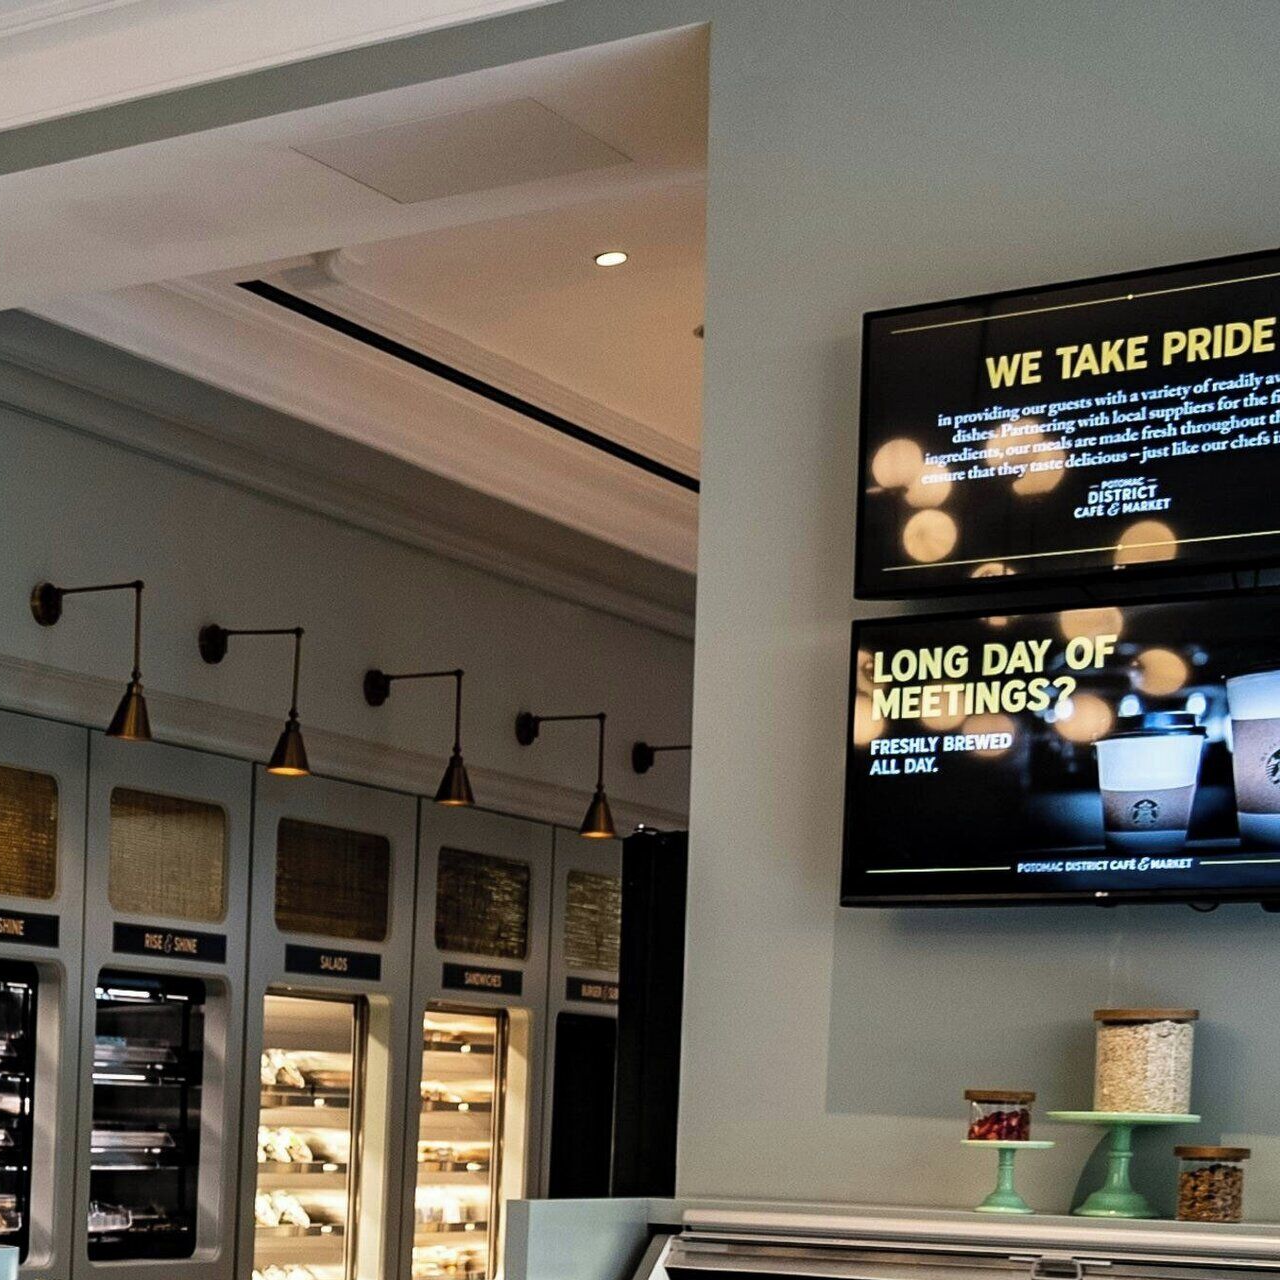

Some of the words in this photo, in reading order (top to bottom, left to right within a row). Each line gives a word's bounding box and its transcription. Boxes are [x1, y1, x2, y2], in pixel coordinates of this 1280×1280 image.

[986, 350, 1042, 389] WE
[1056, 336, 1149, 379] TAKE
[1162, 317, 1276, 365] PRIDE
[938, 413, 952, 427] in
[954, 406, 1020, 429] providing
[1022, 403, 1047, 416] our
[1048, 398, 1090, 417] guests
[1095, 390, 1127, 407] with
[1130, 391, 1138, 402] a
[1141, 385, 1192, 400] variety
[1193, 378, 1213, 394] of
[1212, 372, 1264, 391] readily
[1001, 418, 1075, 438] Partnering
[1078, 411, 1109, 428] with
[1112, 407, 1146, 424] local
[1149, 401, 1214, 421] suppliers
[1217, 396, 1241, 411] for
[1243, 392, 1268, 407] the
[1006, 443, 1031, 456] our
[1032, 436, 1072, 452] meals
[1074, 434, 1097, 447] are
[1099, 428, 1139, 445] made
[1141, 422, 1177, 440] fresh
[1180, 414, 1266, 434] throughout
[967, 465, 995, 480] that
[998, 462, 1027, 478] they
[1030, 458, 1063, 472] taste
[1065, 451, 1128, 468] delicious
[1141, 446, 1170, 463] just
[1171, 441, 1199, 456] like
[1201, 439, 1228, 452] our
[1230, 430, 1270, 448] chefs
[1087, 484, 1158, 504] DISTRICT
[1107, 502, 1120, 516] &
[1122, 497, 1172, 513] MARKET
[873, 645, 968, 684] LONG
[982, 639, 1051, 676] DAY
[1065, 634, 1118, 670] OF
[871, 676, 1077, 721] MEETINGS?
[870, 736, 939, 756] FRESHLY
[943, 732, 1013, 752] BREWED
[869, 758, 900, 776] ALL
[904, 756, 939, 775] DAY.
[1065, 860, 1109, 872] DISTRICT
[1150, 857, 1193, 870] MARKET
[144, 934, 163, 950] RISE
[175, 935, 198, 953] SHINE
[320, 955, 347, 972] SALADS
